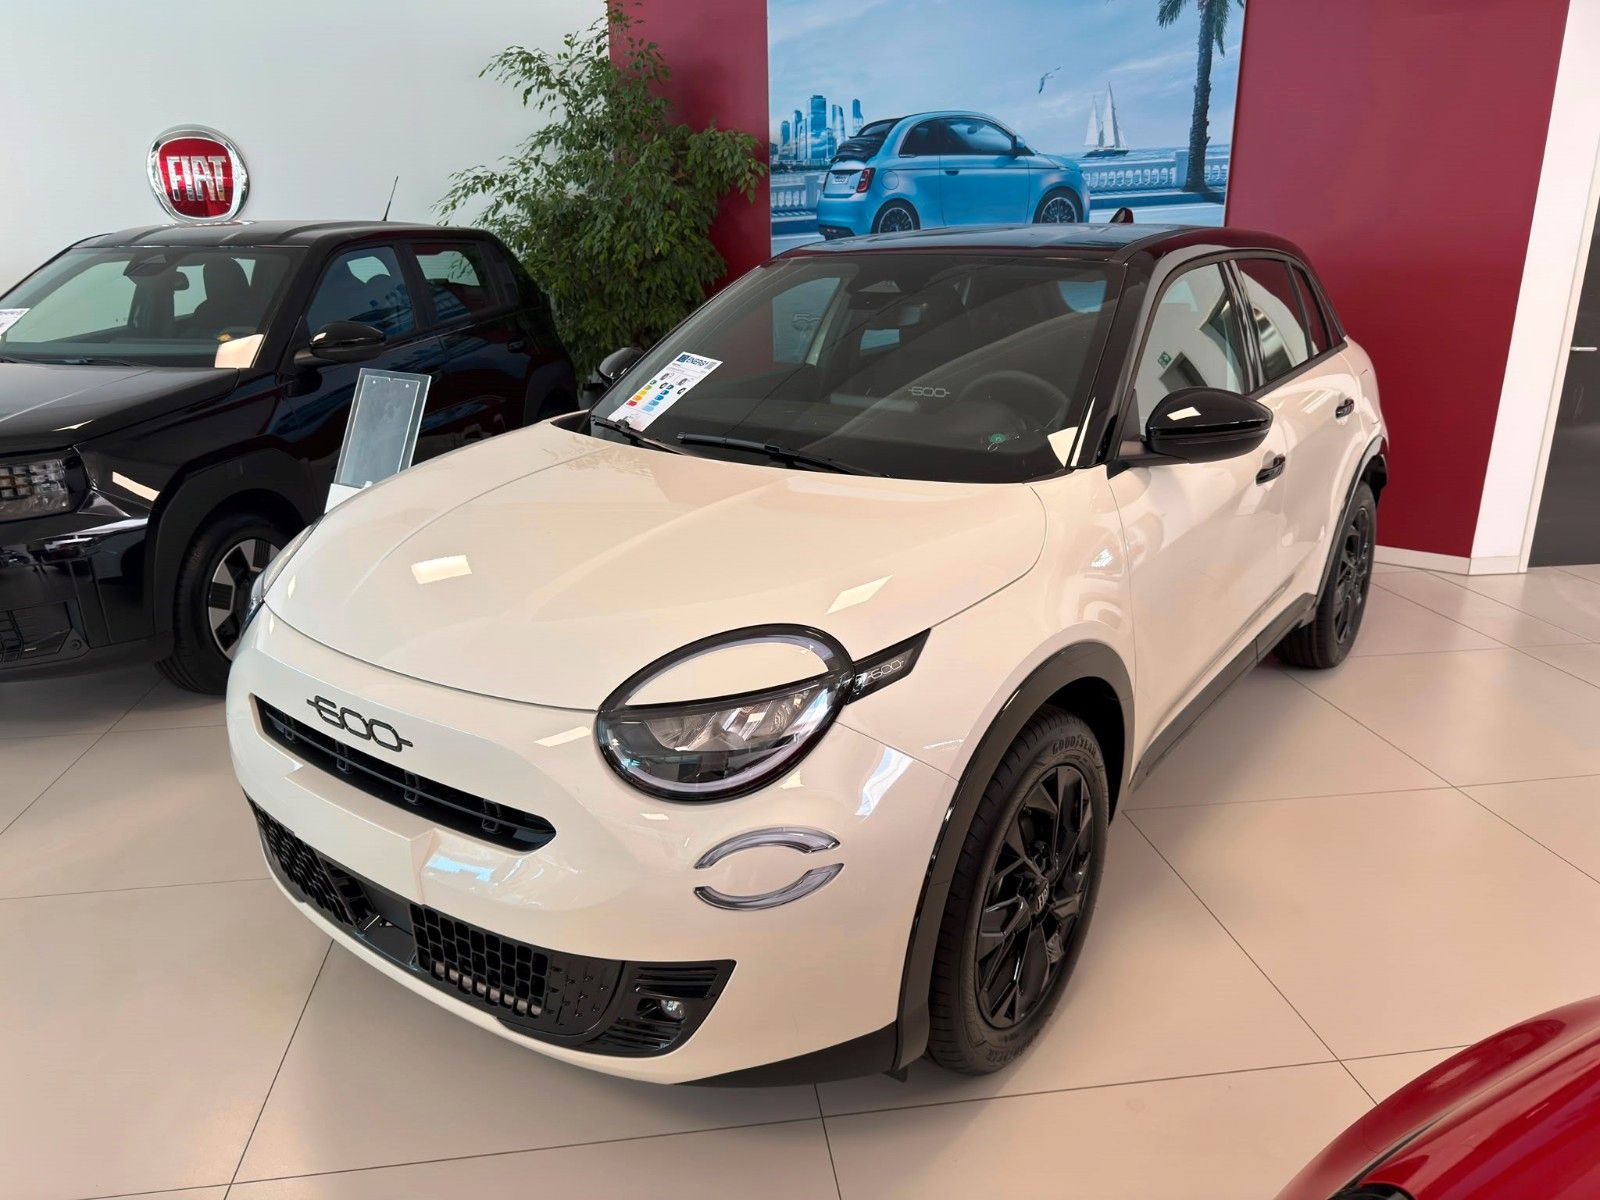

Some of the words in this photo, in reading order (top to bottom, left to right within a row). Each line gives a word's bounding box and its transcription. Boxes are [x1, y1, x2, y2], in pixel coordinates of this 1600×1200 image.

[166, 155, 226, 202] FIAT
[867, 659, 905, 680] 600
[306, 695, 413, 752] 600
